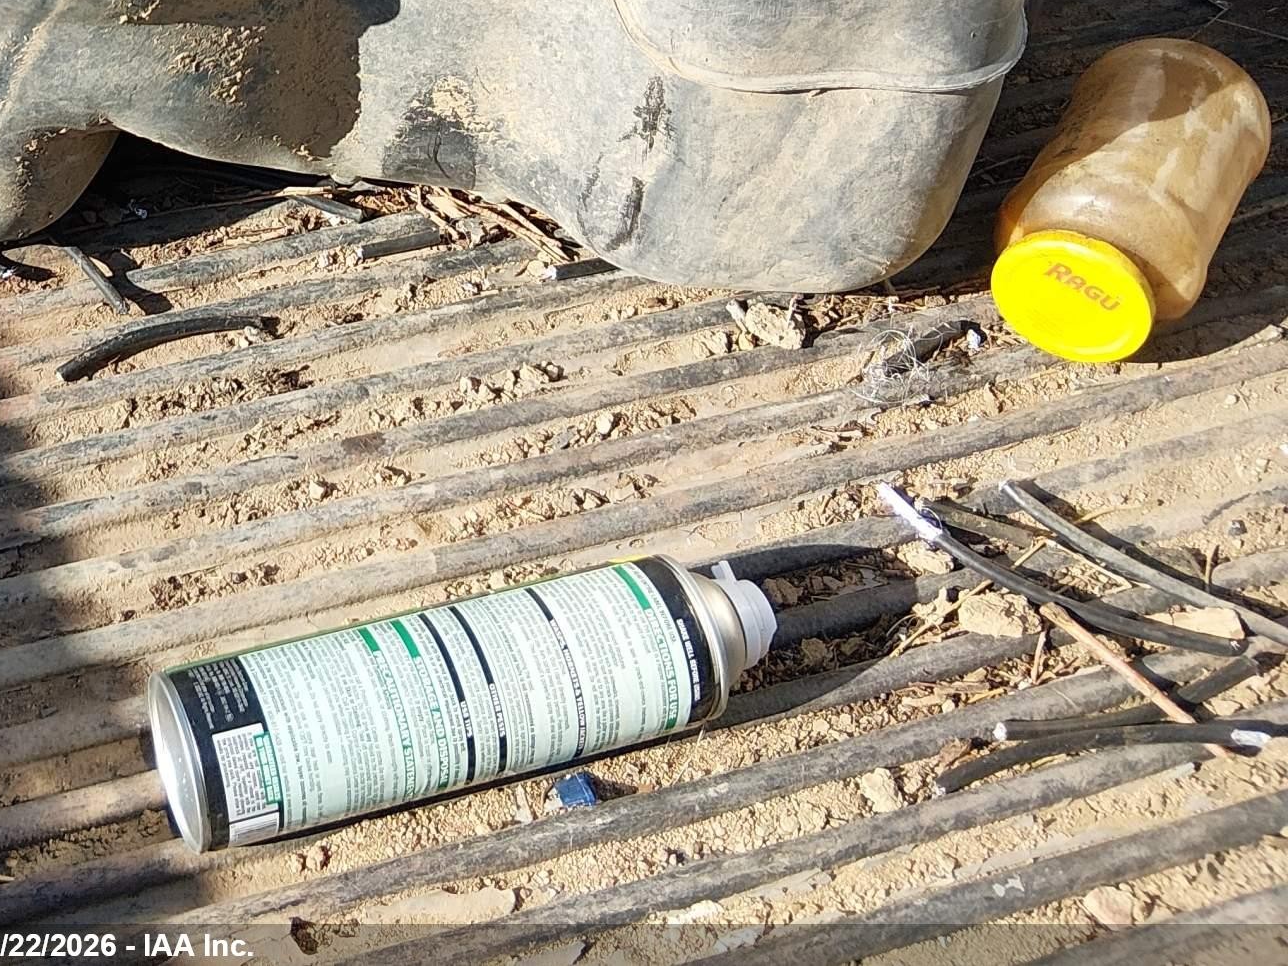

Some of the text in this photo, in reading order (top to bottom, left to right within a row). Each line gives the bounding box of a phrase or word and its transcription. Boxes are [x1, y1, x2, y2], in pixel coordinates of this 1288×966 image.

[644, 607, 678, 720] DIRECTIONS FOR USE
[683, 640, 694, 658] WELL
[373, 649, 411, 746] PRECAUTIONARY
[412, 655, 446, 783] STORAGE AND DISPOSAL
[488, 683, 505, 737] OTHER PESTS
[574, 688, 581, 696] &
[576, 696, 585, 726] YELLOW
